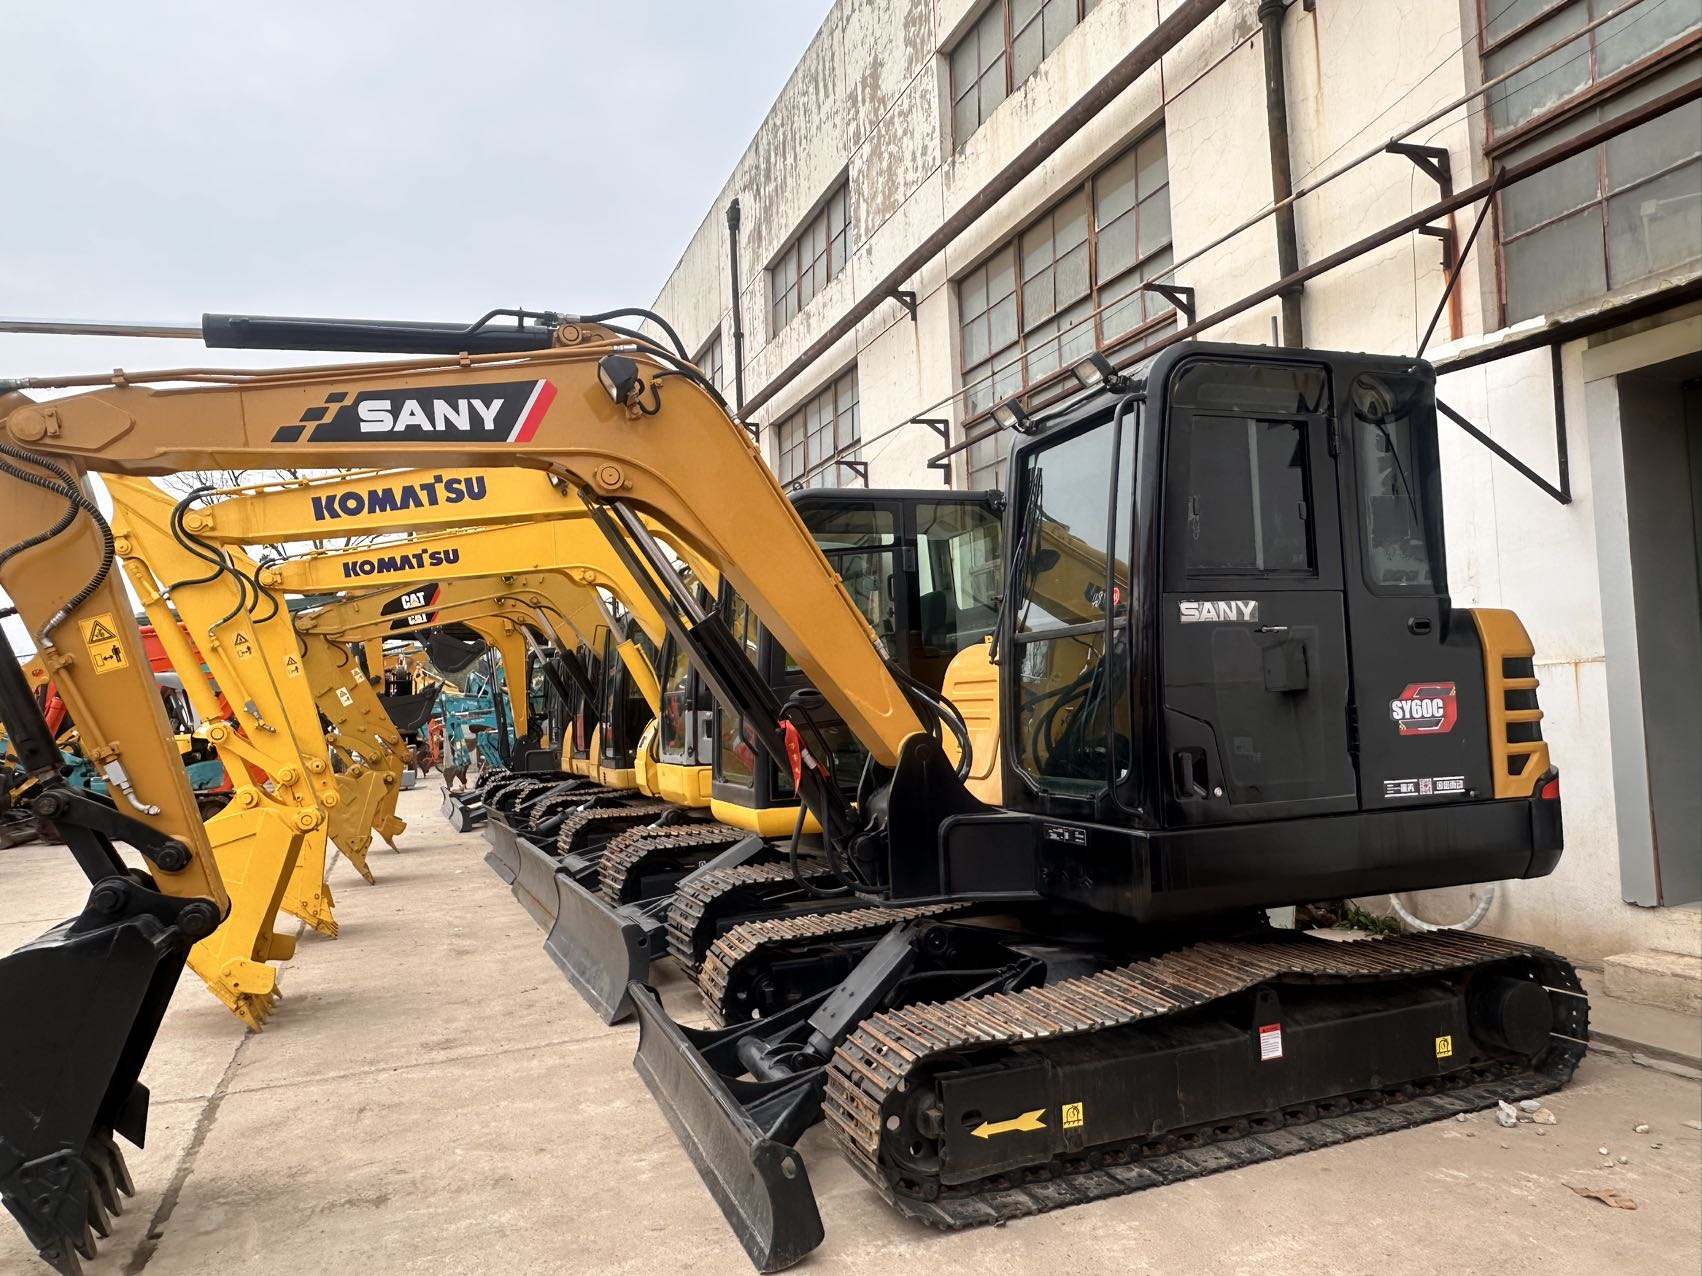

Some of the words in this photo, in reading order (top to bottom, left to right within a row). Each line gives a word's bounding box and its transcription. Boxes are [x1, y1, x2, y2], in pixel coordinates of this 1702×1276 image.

[357, 398, 505, 432] SANY
[311, 474, 487, 521] KOMATSU
[342, 548, 460, 578] KOMATSU
[401, 591, 425, 610] CAT
[1179, 600, 1256, 623] SANY
[1391, 698, 1444, 720] SY60C
